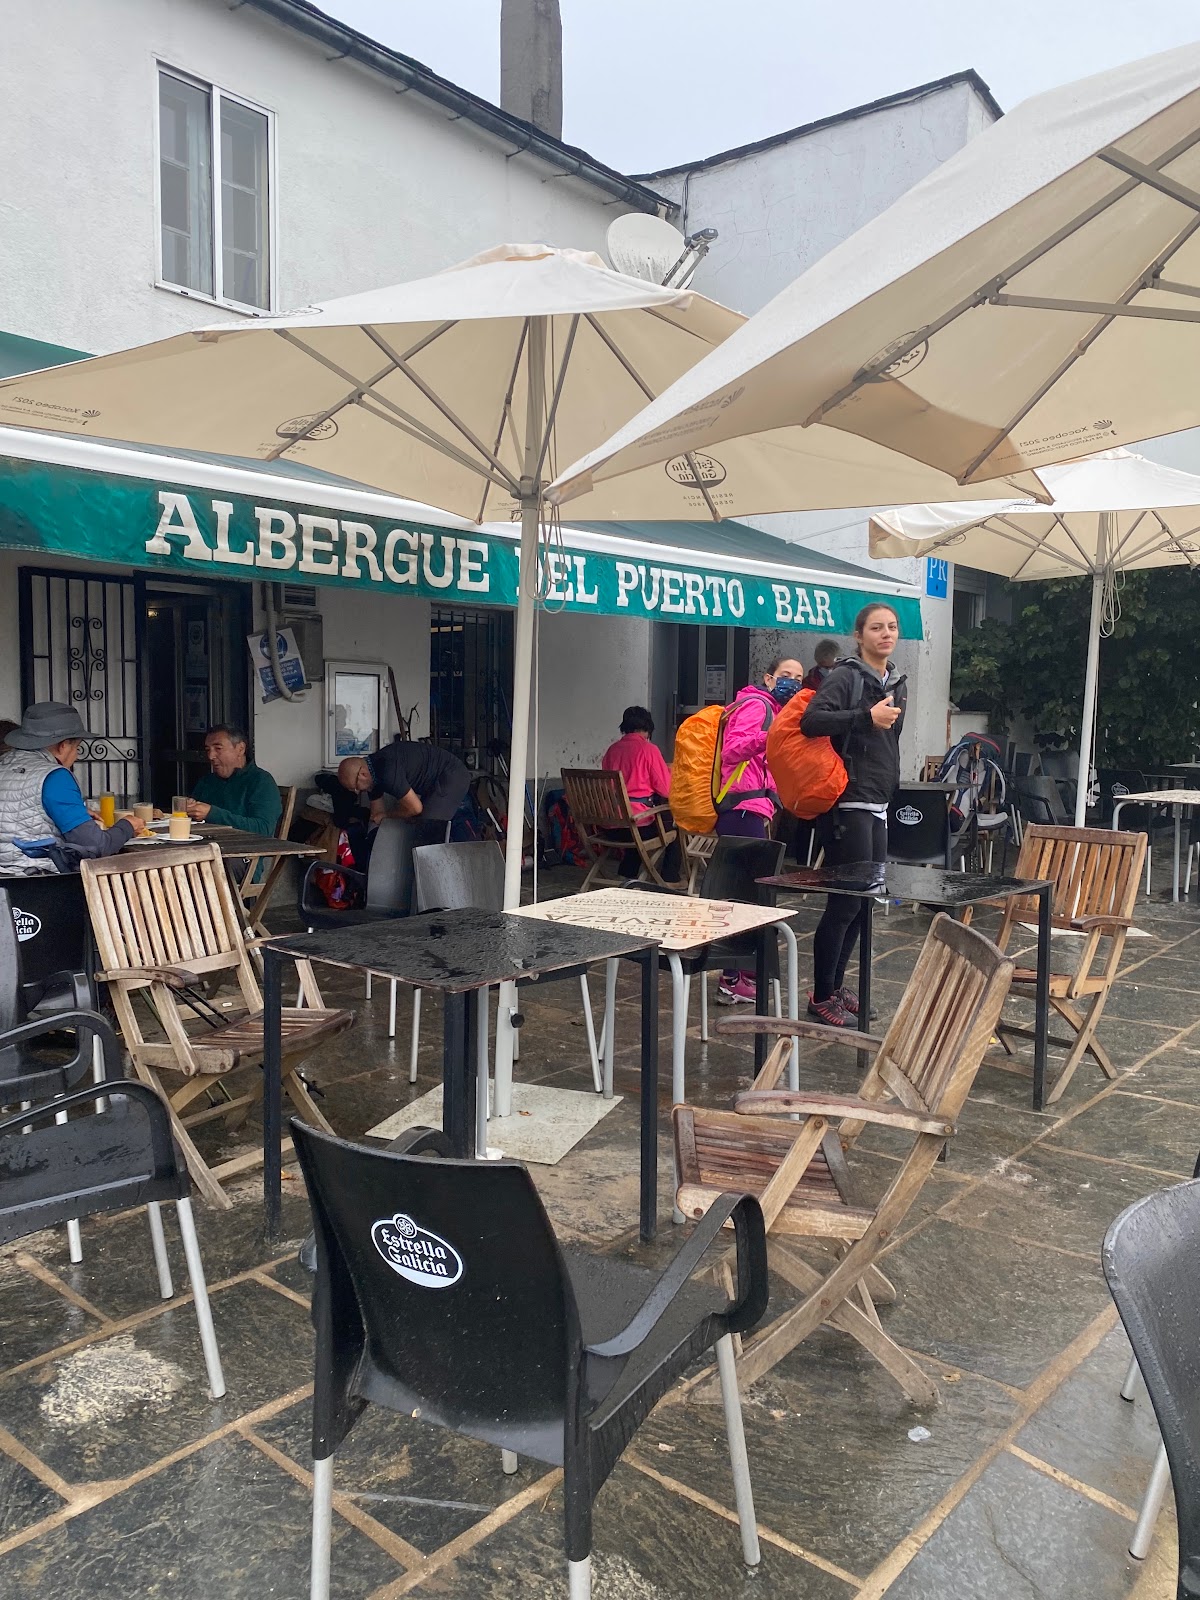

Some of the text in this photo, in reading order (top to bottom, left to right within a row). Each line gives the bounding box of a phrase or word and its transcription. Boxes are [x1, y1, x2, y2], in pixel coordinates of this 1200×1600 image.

[145, 490, 490, 593] ALBERGUE
[615, 561, 746, 618] PUERTO
[771, 584, 835, 627] BAR
[545, 913, 730, 928] CERVEZA
[381, 1228, 448, 1260] Estrella
[388, 1245, 449, 1276] Galicia
